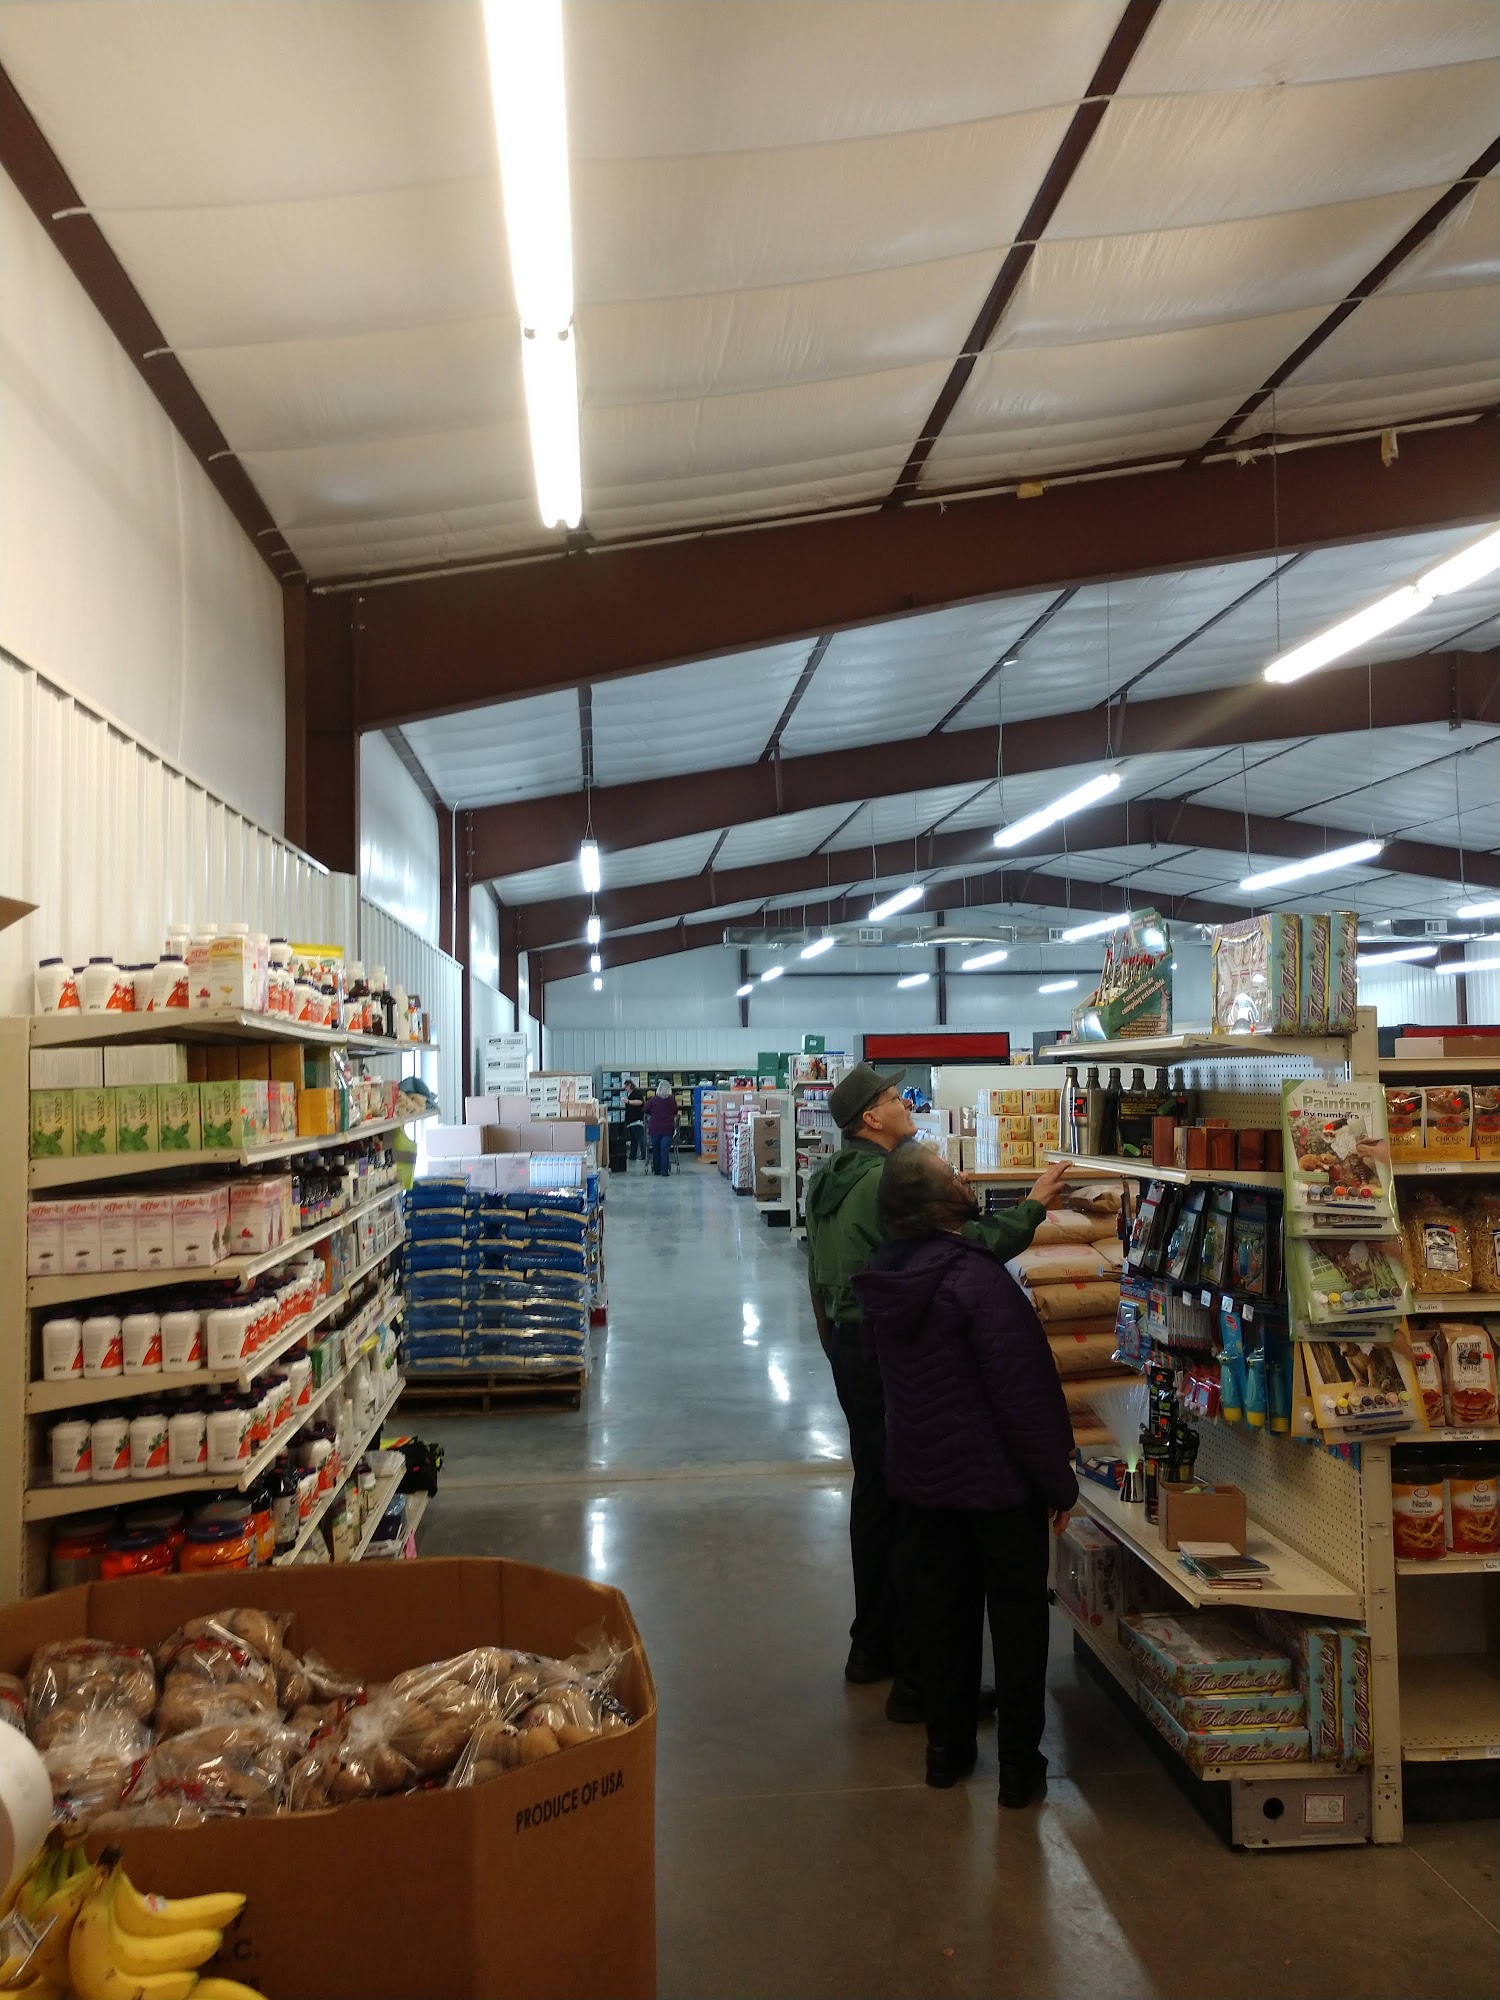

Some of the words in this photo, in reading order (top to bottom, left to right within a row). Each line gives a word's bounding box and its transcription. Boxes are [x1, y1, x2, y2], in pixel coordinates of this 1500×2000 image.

[1281, 924, 1295, 954] Set
[1312, 925, 1326, 954] Set
[1341, 921, 1354, 951] Set
[1282, 957, 1296, 992] Time
[1311, 958, 1325, 992] Time
[1340, 955, 1354, 990] Time
[1121, 997, 1143, 1015] camping
[1141, 978, 1166, 1000] extensible
[1122, 981, 1148, 1004] Fourchette
[1147, 976, 1154, 985] de
[1339, 989, 1354, 1020] Tea
[1282, 991, 1297, 1022] Tea
[1309, 992, 1324, 1023] Tea
[1302, 1095, 1371, 1115] Painting
[1303, 1110, 1315, 1119] by
[1317, 1111, 1360, 1120] numbers
[1411, 1500, 1433, 1508] Nacho
[1472, 1494, 1491, 1503] Nacho
[1320, 1645, 1334, 1676] Set
[1352, 1647, 1368, 1679] Set
[1189, 1673, 1217, 1691] Tea
[1216, 1672, 1251, 1690] Time
[1252, 1670, 1281, 1687] Set
[1321, 1681, 1335, 1717] Time
[1354, 1682, 1369, 1719] Time
[1199, 1709, 1227, 1727] Tea
[1227, 1708, 1262, 1726] Time
[1263, 1706, 1294, 1724] Set
[1320, 1717, 1336, 1748] Tea
[1354, 1719, 1370, 1751] Tea
[1202, 1744, 1232, 1763] Tea
[1231, 1743, 1267, 1761] Time
[1268, 1742, 1299, 1760] Set
[516, 1788, 579, 1834] PRODUCE
[581, 1780, 599, 1806] OF
[601, 1769, 624, 1798] USA
